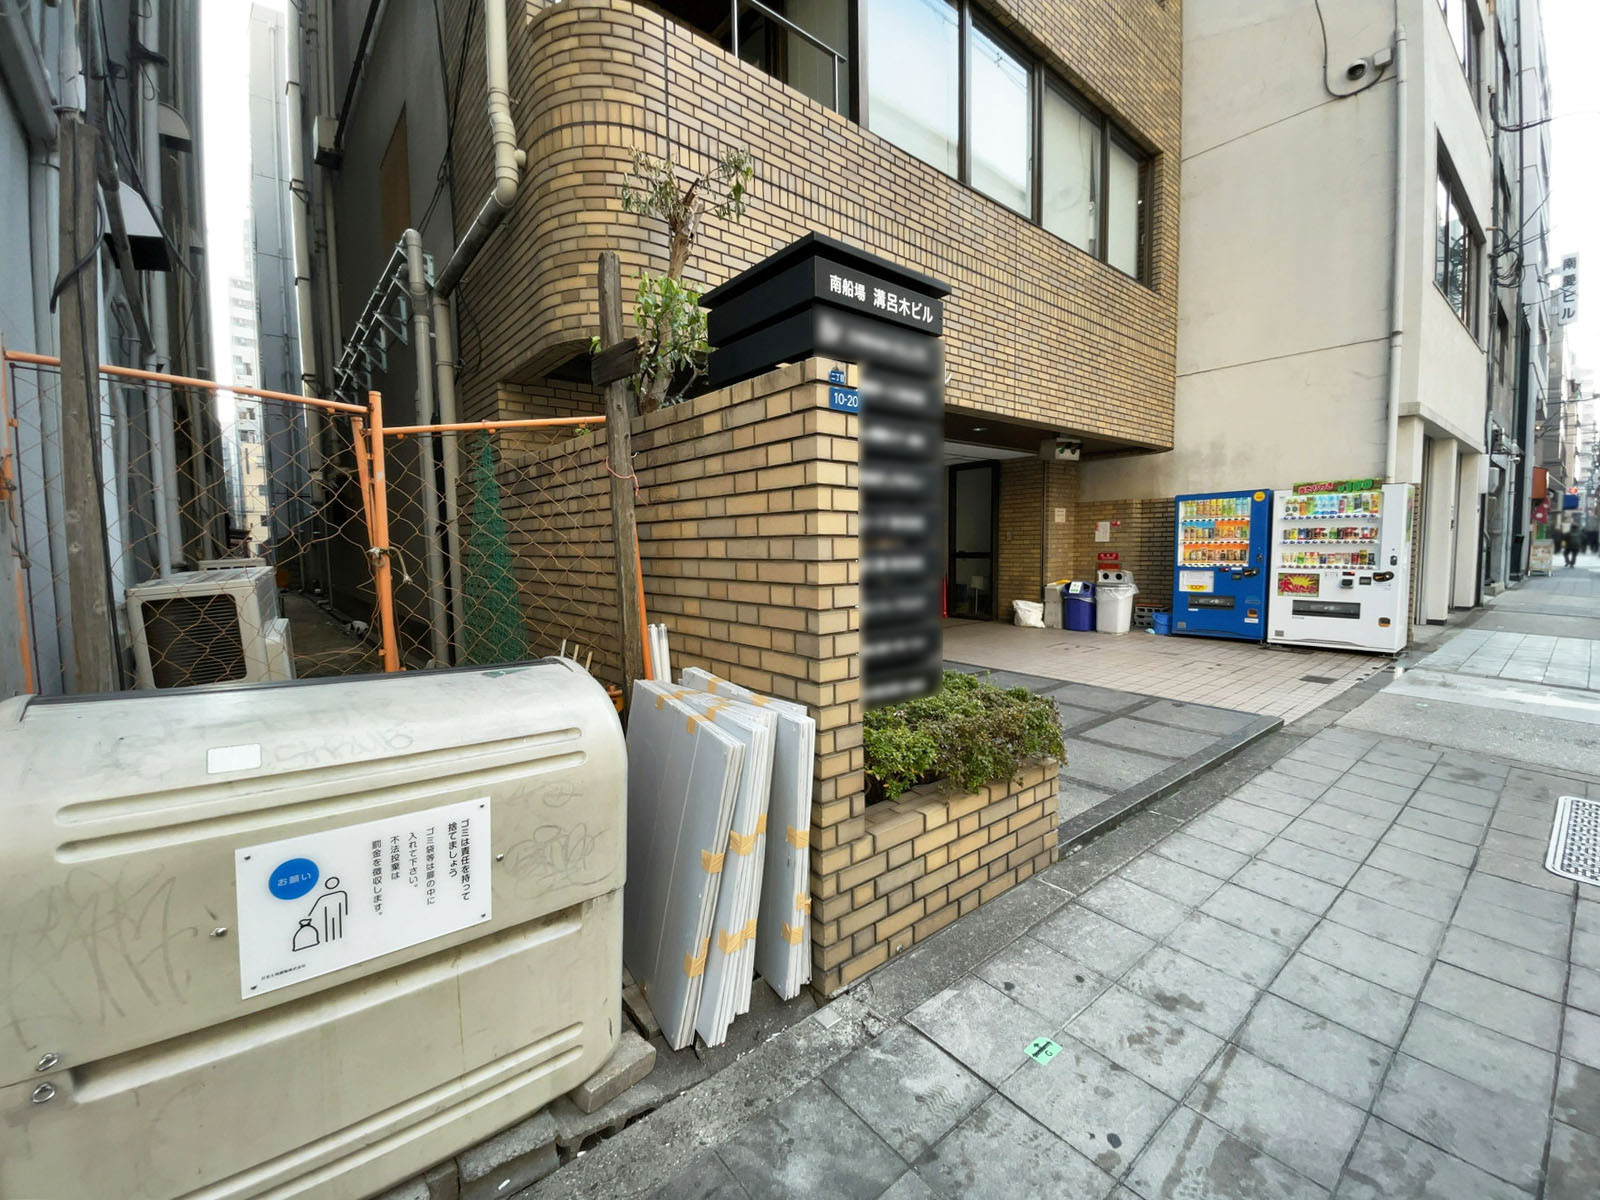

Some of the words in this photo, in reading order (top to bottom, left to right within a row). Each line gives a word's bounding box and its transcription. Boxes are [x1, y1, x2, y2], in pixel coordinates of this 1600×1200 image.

[829, 274, 866, 302] 南船場
[873, 287, 934, 324] 溝呂木ビル
[834, 392, 858, 408] 10-20
[390, 835, 400, 880] 不法投棄は
[408, 832, 418, 887] 入れて下さい。
[448, 821, 458, 878] 捨てましょう
[461, 818, 470, 901] ゴミは責任を持って
[277, 872, 312, 887] お願い
[372, 839, 383, 916] 罰金を徴収します。
